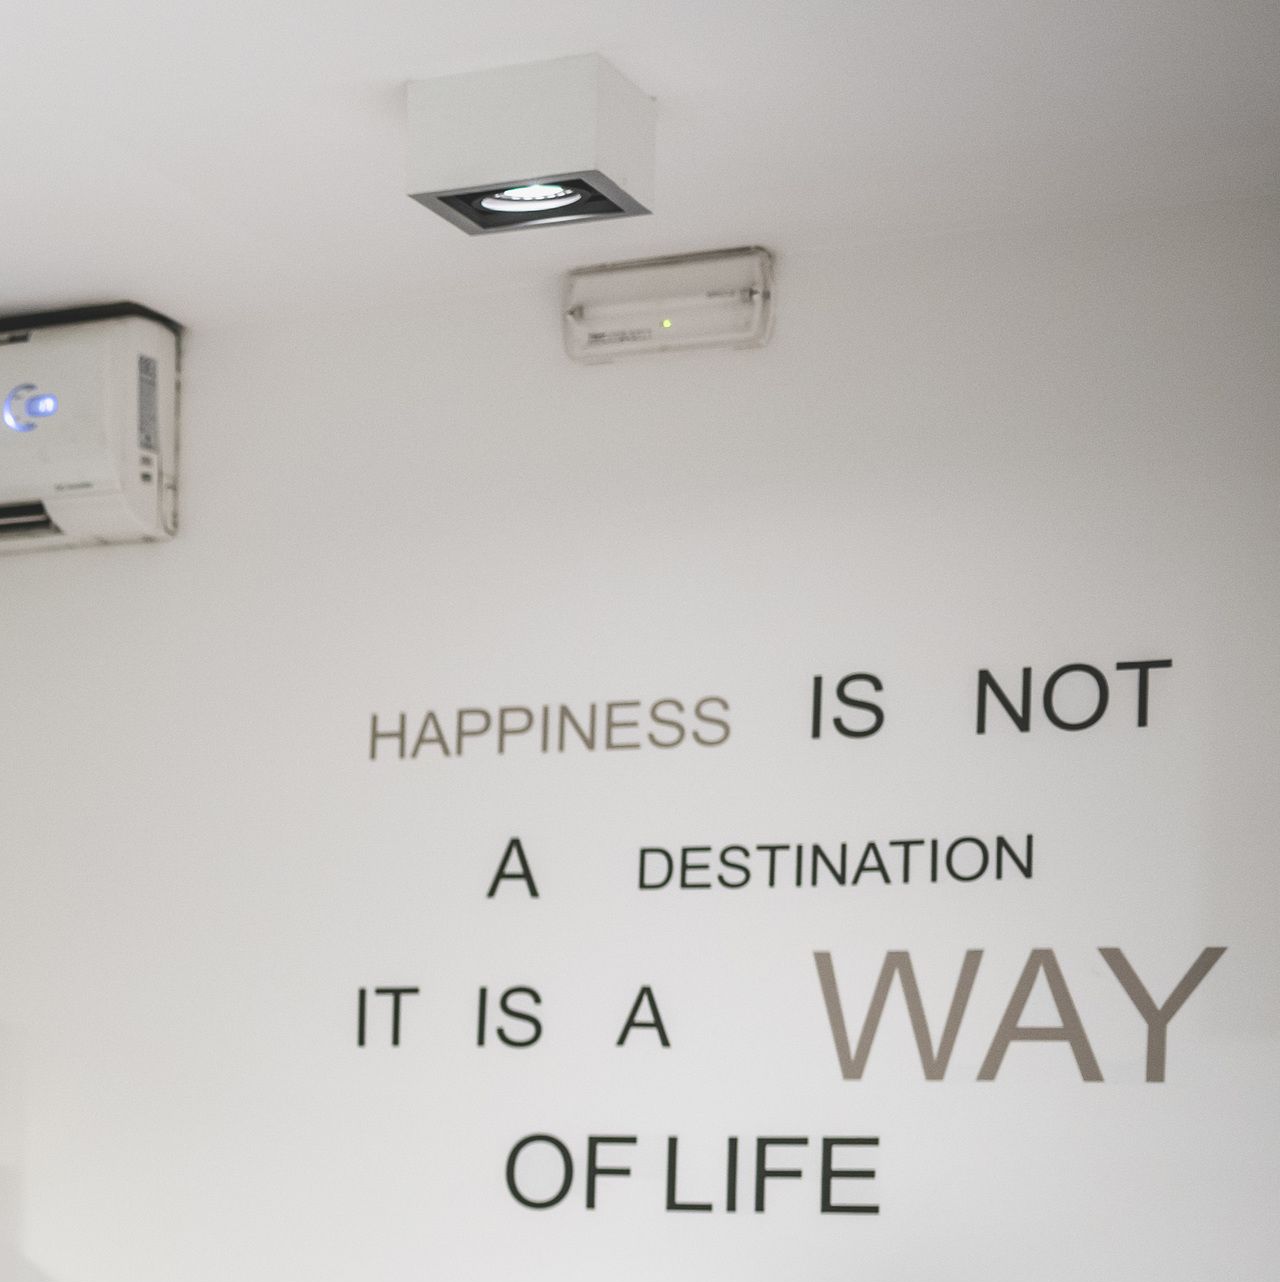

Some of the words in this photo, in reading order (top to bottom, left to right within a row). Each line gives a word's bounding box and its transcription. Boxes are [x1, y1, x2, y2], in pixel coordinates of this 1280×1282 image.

[368, 695, 732, 762] HAPPINESS
[811, 672, 885, 740] IS
[975, 658, 1174, 736] NOT
[486, 837, 540, 899] A
[638, 833, 1034, 891] DESTINATION
[357, 986, 421, 1048] IT
[476, 985, 543, 1049] IS
[615, 985, 671, 1049] A
[813, 946, 1229, 1084] WAY
[505, 1133, 638, 1211] OF
[665, 1135, 881, 1216] LIFE
